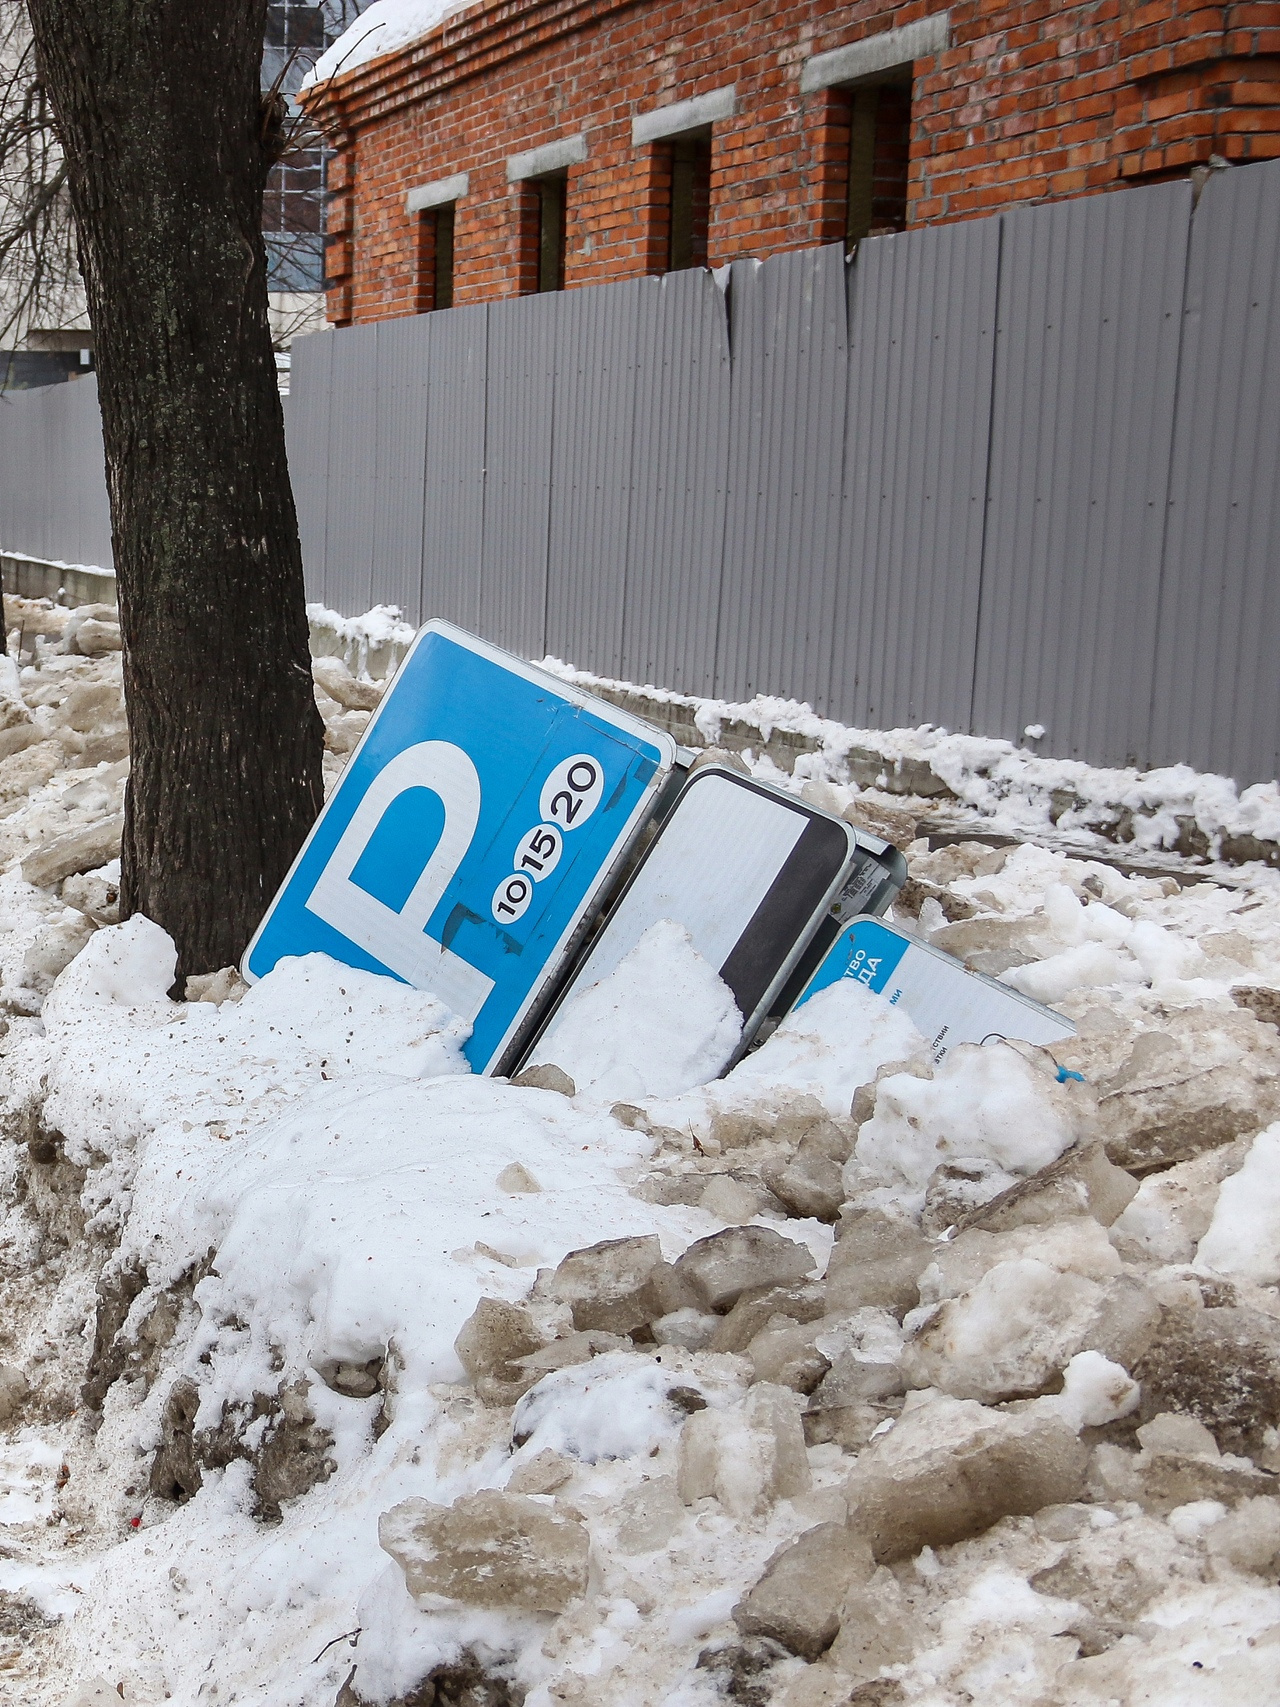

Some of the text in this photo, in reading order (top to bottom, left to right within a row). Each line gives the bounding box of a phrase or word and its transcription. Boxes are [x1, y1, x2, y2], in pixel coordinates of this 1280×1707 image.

[304, 740, 496, 1024] P
[497, 761, 597, 916] 10 15 20
